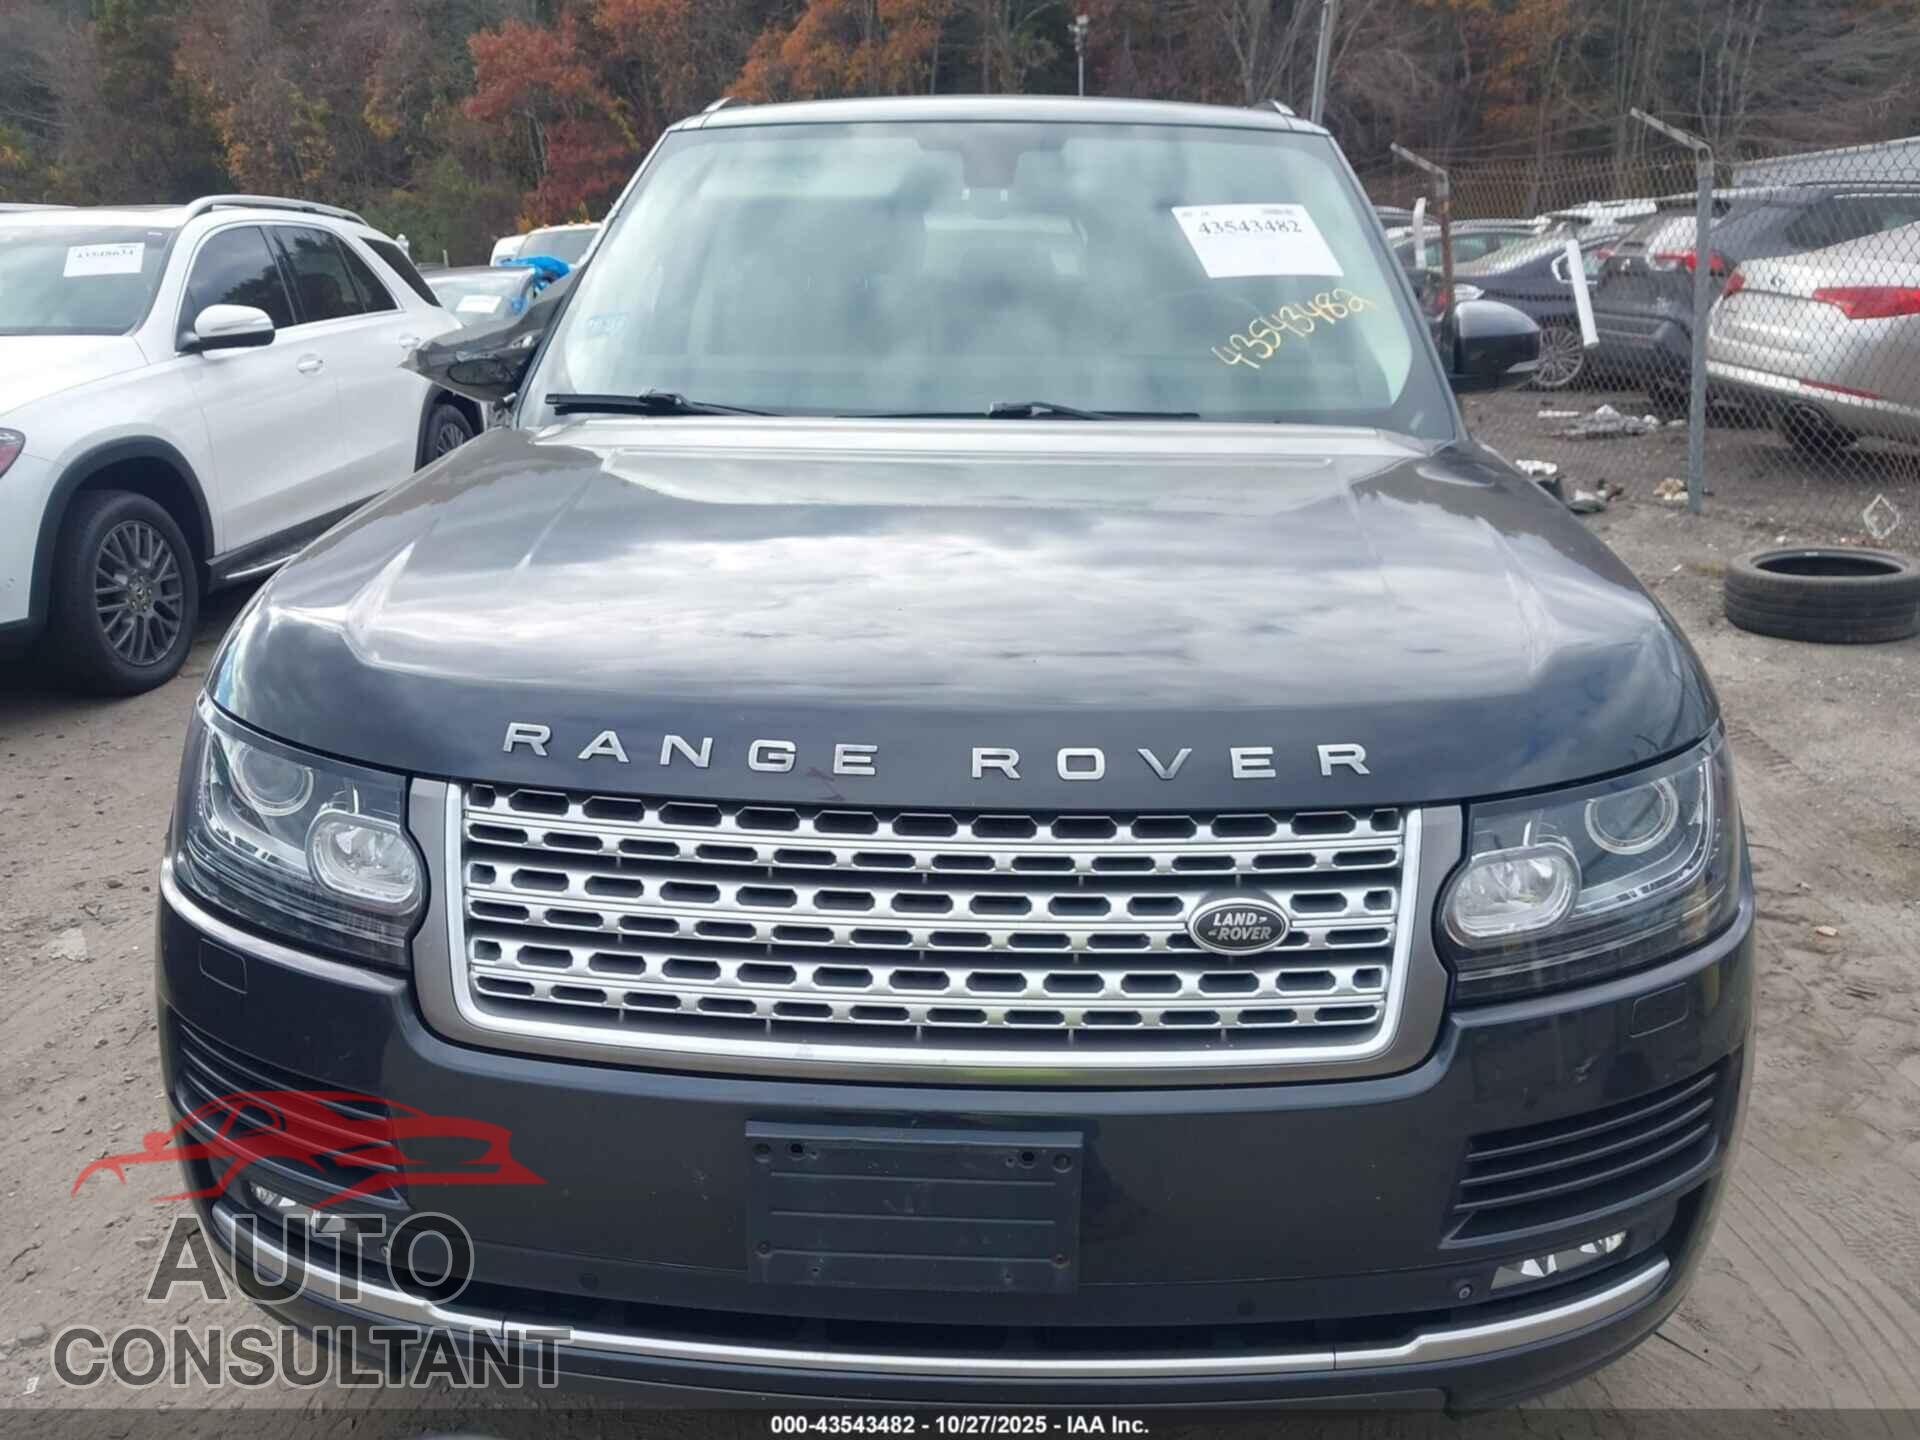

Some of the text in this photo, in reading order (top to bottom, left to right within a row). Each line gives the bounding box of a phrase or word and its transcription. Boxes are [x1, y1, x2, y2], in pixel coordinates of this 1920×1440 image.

[1198, 219, 1303, 235] 43543482
[1210, 288, 1376, 369] 43543482
[503, 721, 1371, 781] RANGE ROVER
[1217, 926, 1272, 940] ROVER
